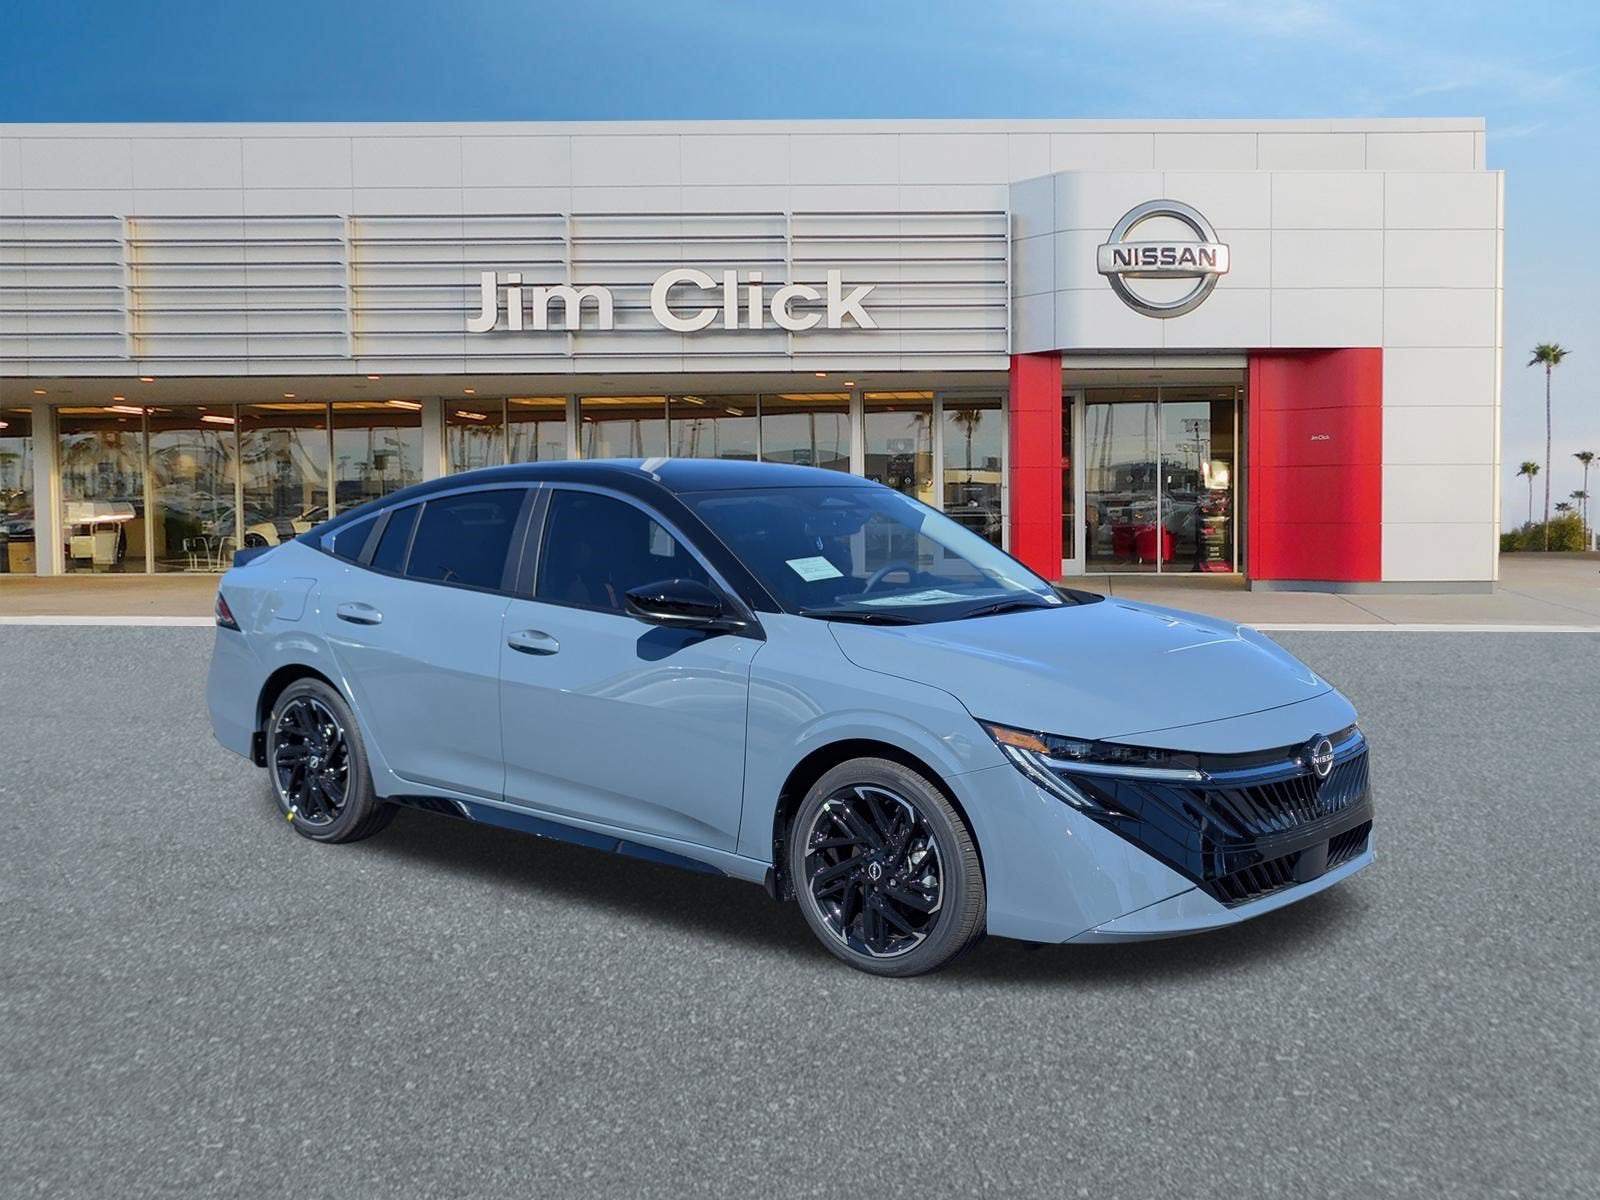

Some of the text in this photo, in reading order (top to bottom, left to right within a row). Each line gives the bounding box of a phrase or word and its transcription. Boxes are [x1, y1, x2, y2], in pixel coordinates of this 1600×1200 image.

[1112, 247, 1217, 267] NISSAN
[466, 268, 879, 333] Jim Click
[1313, 754, 1333, 764] NISS
